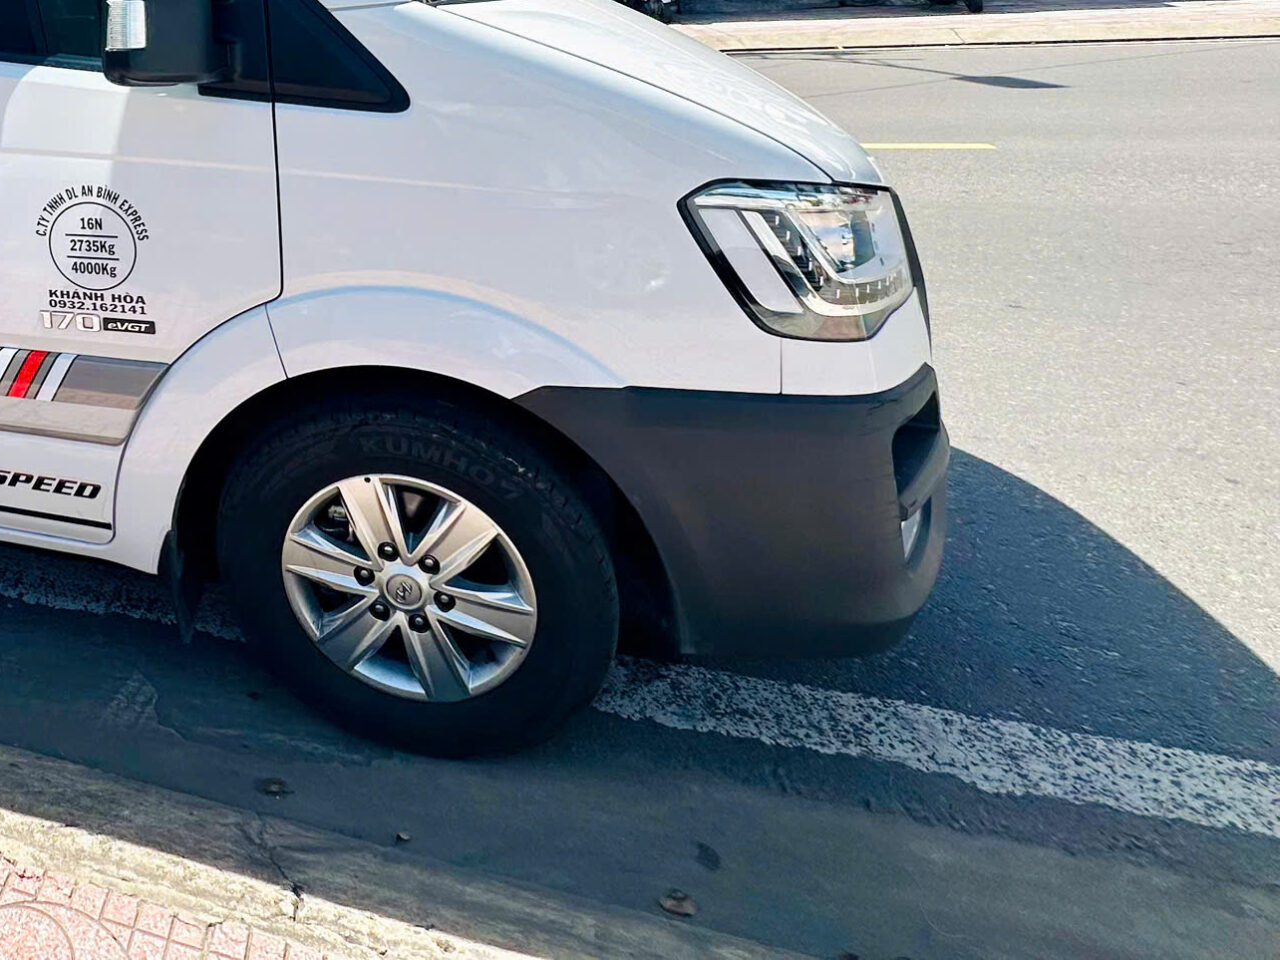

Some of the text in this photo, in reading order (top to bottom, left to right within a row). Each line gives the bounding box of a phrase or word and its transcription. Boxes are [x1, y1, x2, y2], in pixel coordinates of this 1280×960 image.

[42, 193, 67, 216] TNHH
[65, 186, 79, 201] DL
[81, 185, 93, 197] AN
[97, 184, 120, 204] BÌNH
[118, 200, 149, 242] EXPRESS
[80, 217, 103, 230] 16N
[70, 239, 115, 255] 2735Kg
[71, 262, 117, 278] 4000Kg
[48, 289, 146, 305] KHÁNH HÒA
[49, 299, 147, 315] 0932.162141
[39, 311, 150, 332] 170 eVGT
